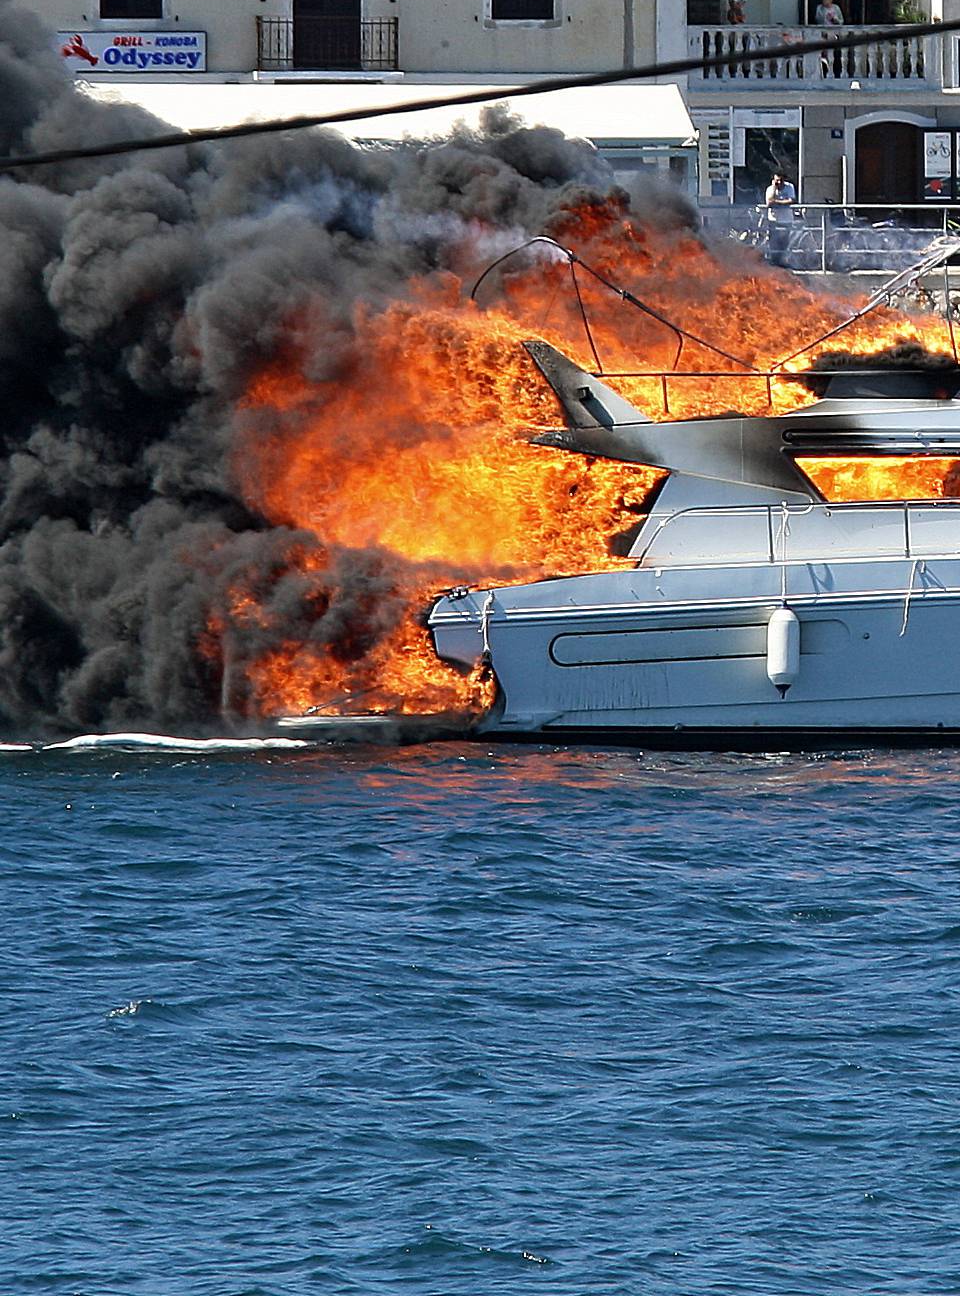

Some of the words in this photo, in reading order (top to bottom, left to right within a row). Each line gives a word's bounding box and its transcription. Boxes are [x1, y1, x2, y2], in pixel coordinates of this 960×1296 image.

[113, 36, 143, 46] GRILL
[155, 36, 197, 46] KONOBA
[104, 47, 202, 69] Odyssey
